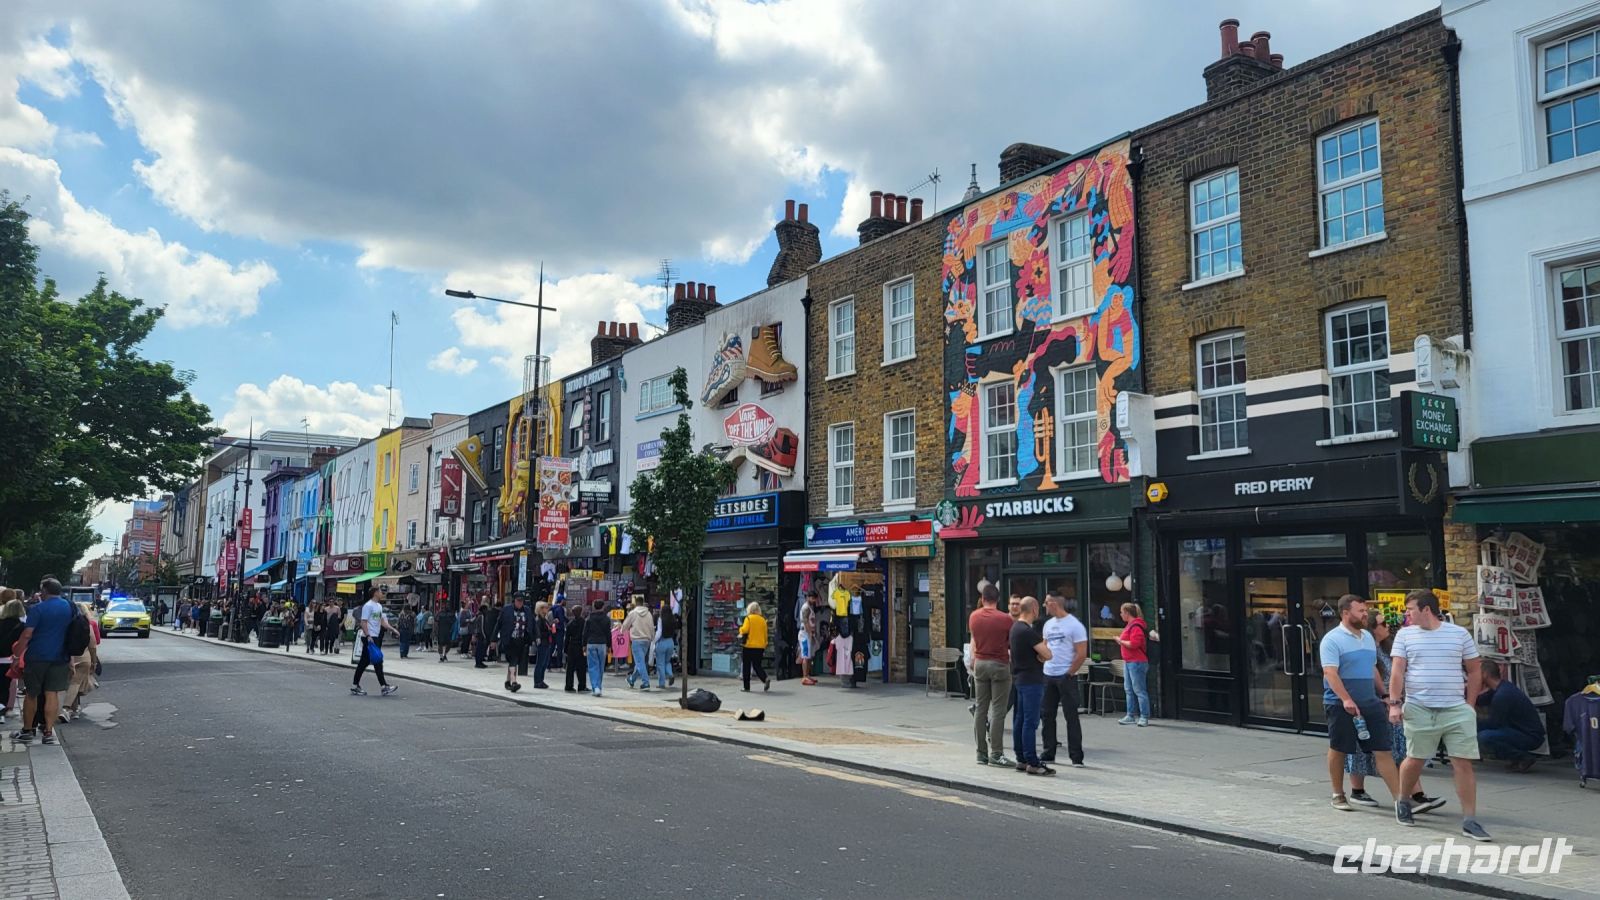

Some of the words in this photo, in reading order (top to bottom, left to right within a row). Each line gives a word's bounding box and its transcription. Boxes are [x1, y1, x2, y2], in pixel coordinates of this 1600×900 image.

[738, 405, 757, 423] VANS
[1422, 409, 1446, 422] MONEY
[740, 421, 753, 438] THE
[1415, 419, 1453, 434] EXCHANGE
[1234, 481, 1268, 496] FRED
[1270, 476, 1314, 493] PERRY
[985, 496, 1075, 518] STARBUCKS
[1477, 617, 1506, 626] LONDON
[616, 636, 625, 645] 10
